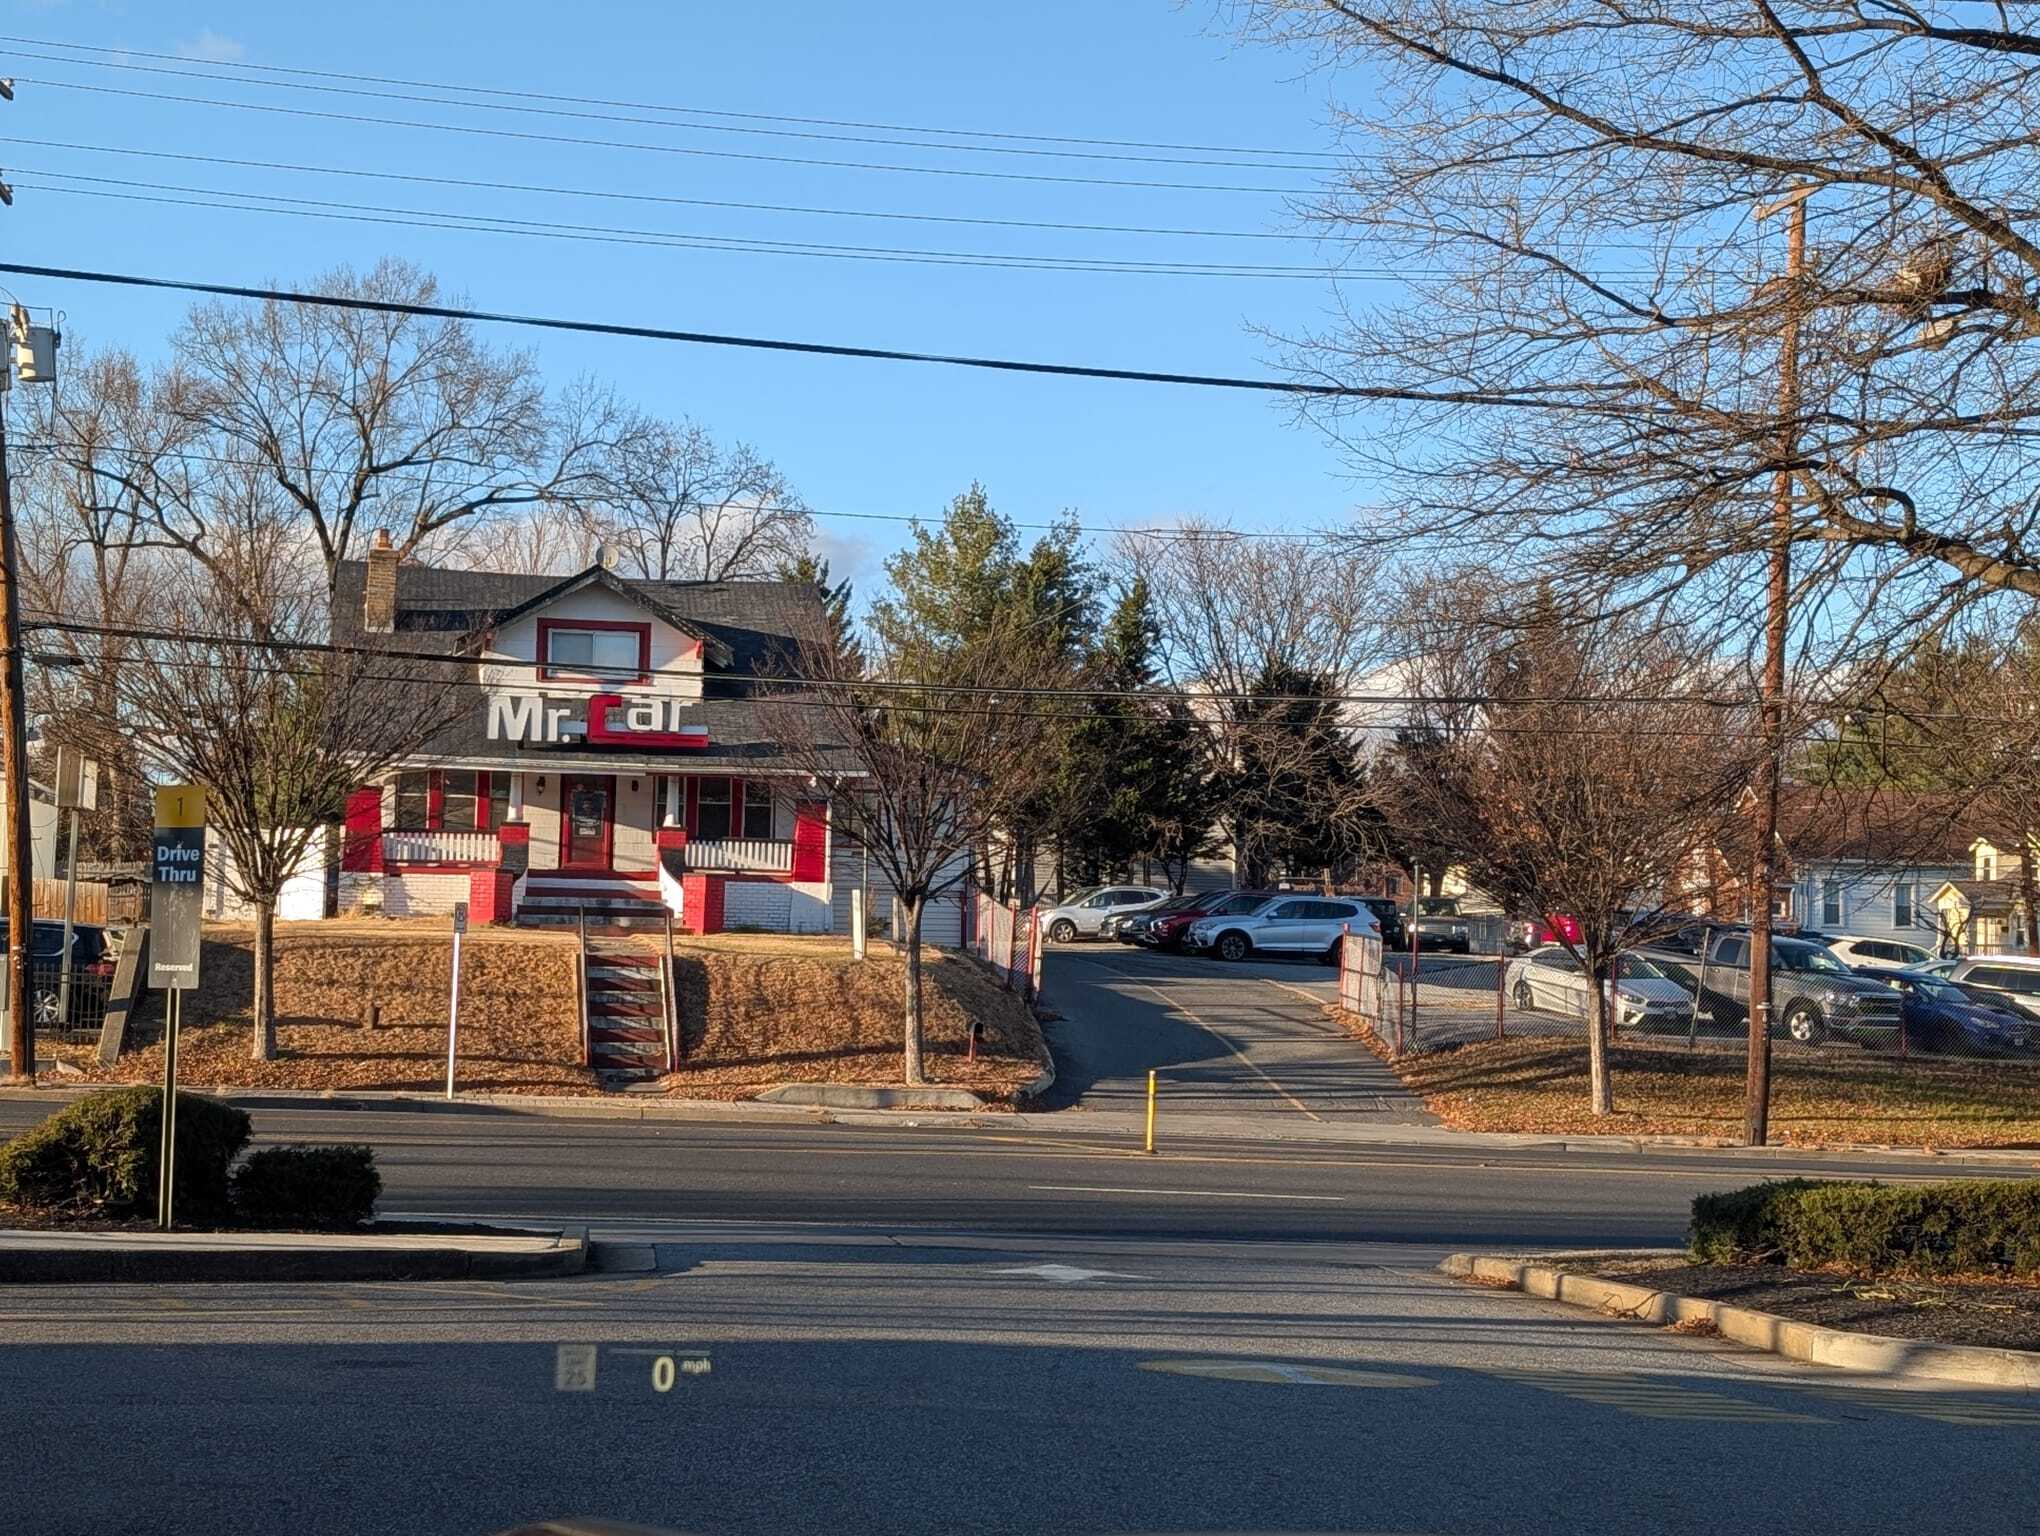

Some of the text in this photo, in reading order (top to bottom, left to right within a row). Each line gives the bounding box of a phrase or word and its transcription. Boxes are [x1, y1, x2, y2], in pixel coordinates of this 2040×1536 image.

[487, 693, 710, 748] Mr. Car
[176, 796, 184, 817] 1
[157, 846, 200, 862] Drive
[158, 866, 197, 882] Thru
[154, 962, 193, 972] Reserved
[653, 1356, 711, 1392] 0 mph
